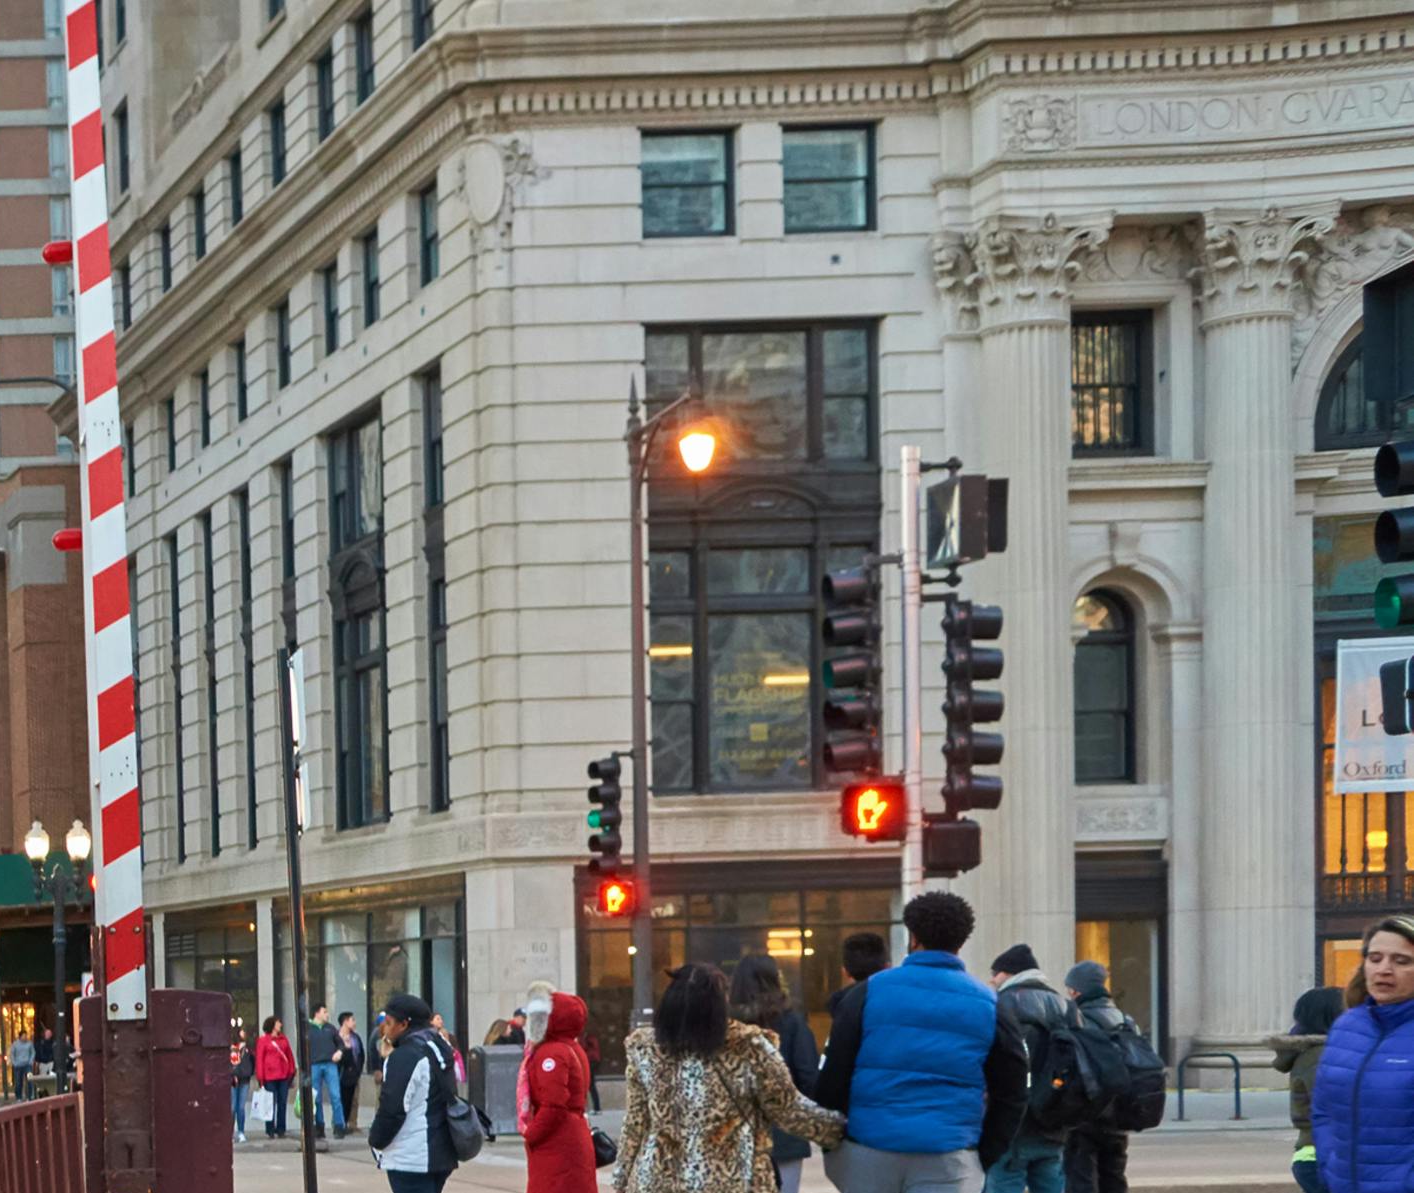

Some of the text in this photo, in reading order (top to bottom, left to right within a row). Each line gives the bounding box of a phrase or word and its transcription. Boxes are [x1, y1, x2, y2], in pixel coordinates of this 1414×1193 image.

[1095, 96, 1262, 136] LONDON
[1362, 708, 1385, 728] L
[1343, 760, 1407, 777] Oxford
